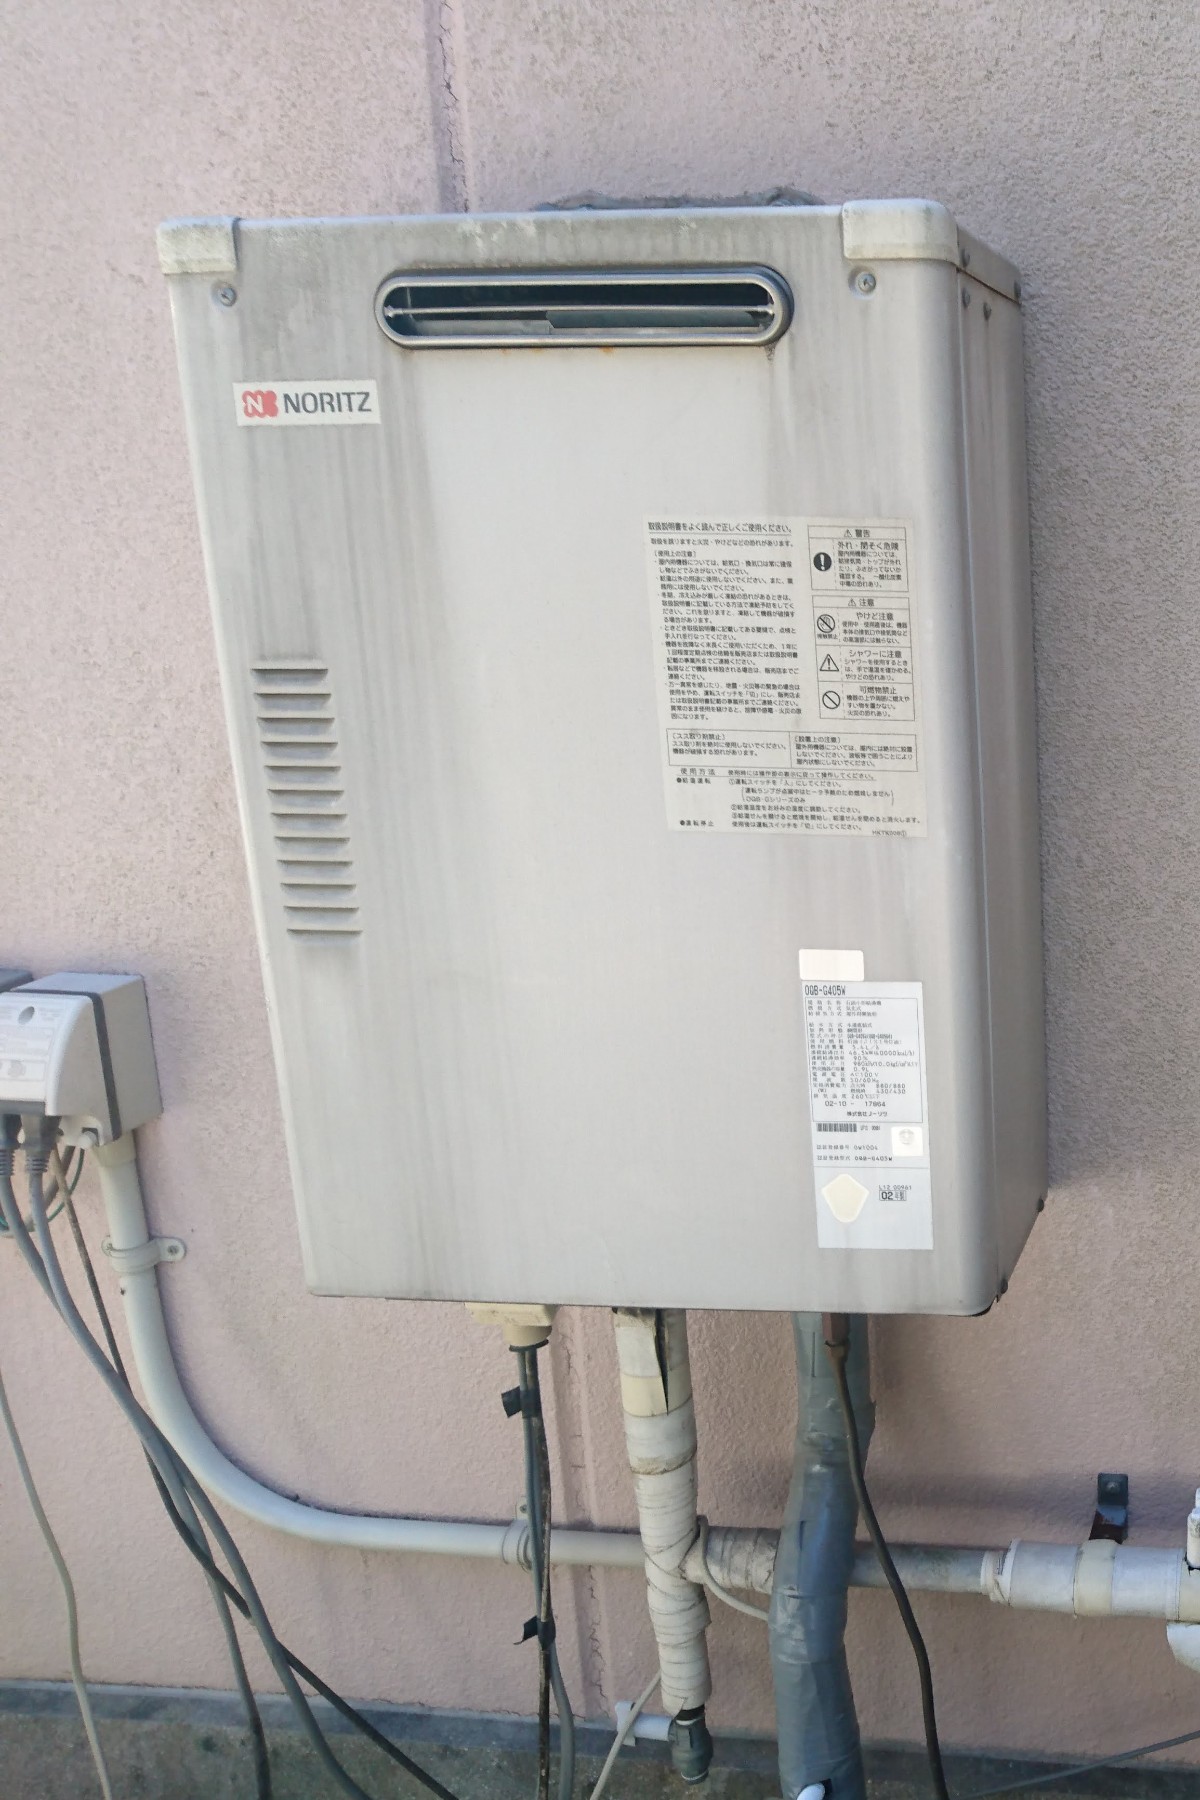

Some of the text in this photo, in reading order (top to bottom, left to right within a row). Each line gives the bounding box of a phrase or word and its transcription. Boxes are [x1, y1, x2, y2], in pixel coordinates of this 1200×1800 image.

[283, 391, 371, 414] NORITZ
[855, 529, 871, 538] 警告
[859, 599, 875, 607] 注意
[856, 612, 894, 621] やけど注意
[849, 650, 902, 660] シャワーに注意
[860, 685, 897, 695] 可燃物禁止
